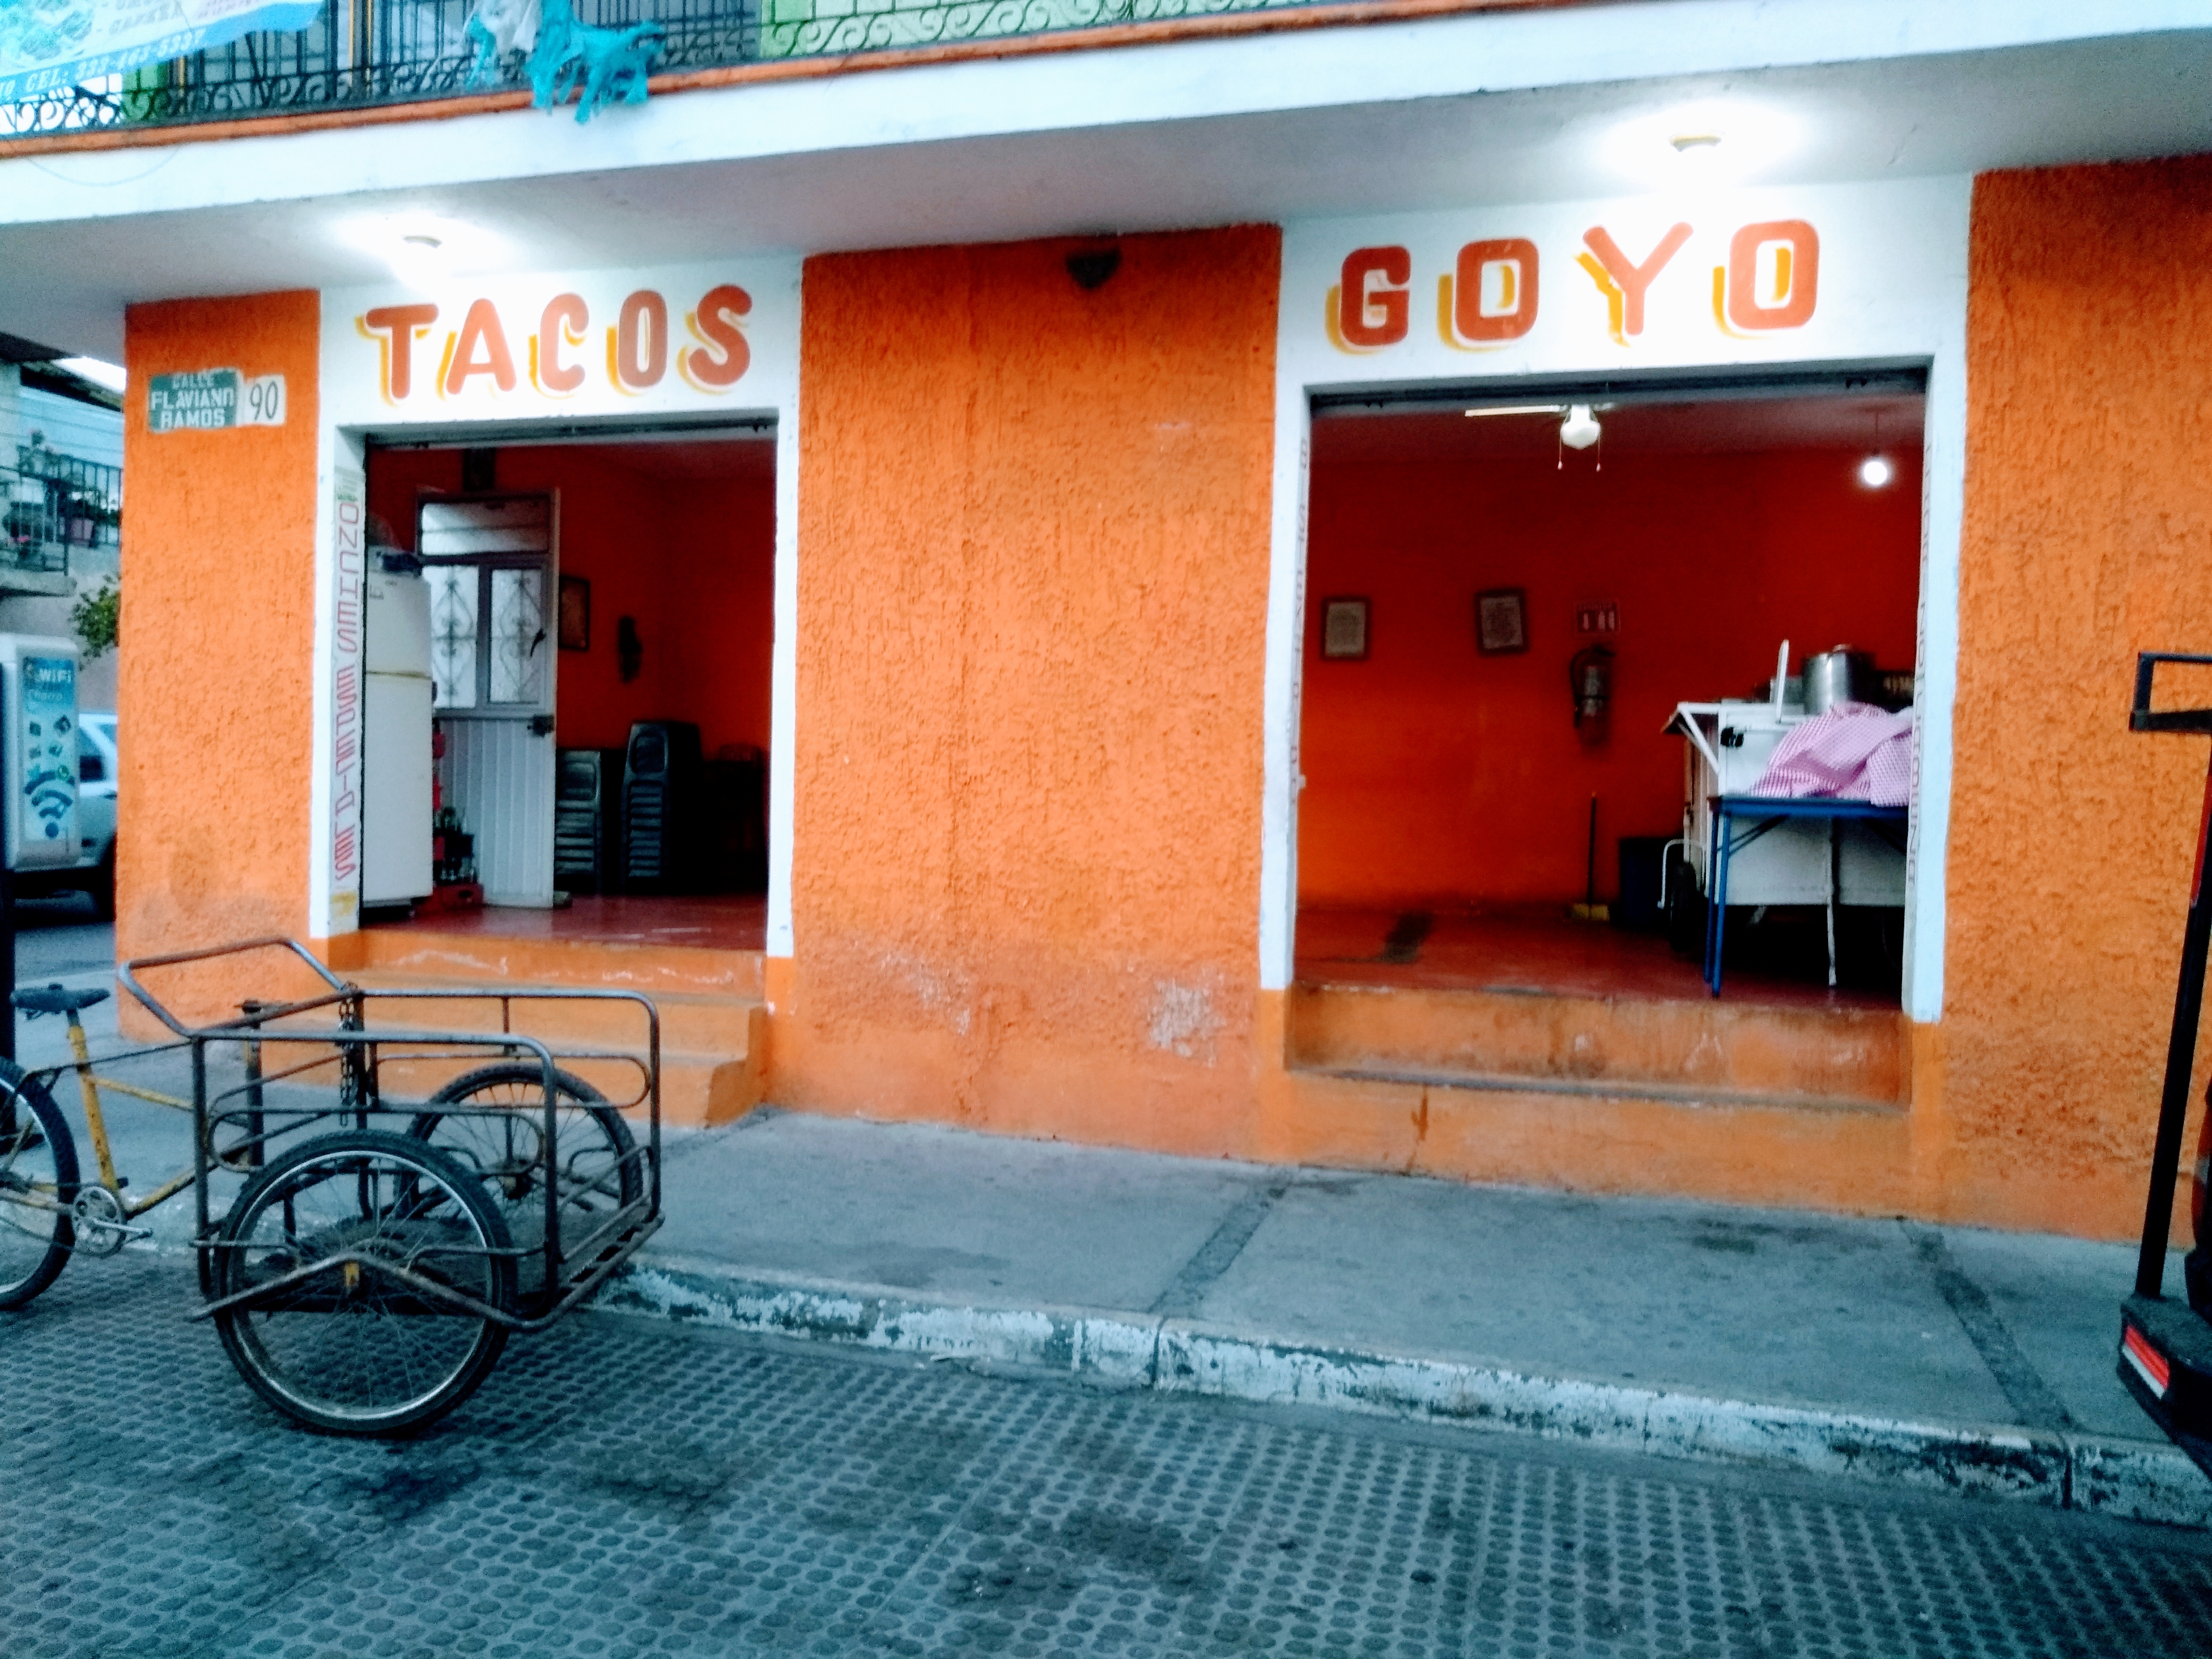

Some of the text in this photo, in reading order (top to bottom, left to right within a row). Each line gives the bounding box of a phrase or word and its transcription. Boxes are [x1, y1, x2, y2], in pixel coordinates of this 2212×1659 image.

[26, 69, 69, 93] CEL:
[1329, 219, 1821, 352] GOYO
[361, 283, 753, 403] TACOS
[161, 408, 225, 428] RAMOS
[249, 380, 279, 422] 90
[1909, 692, 1923, 886] CABEZA
